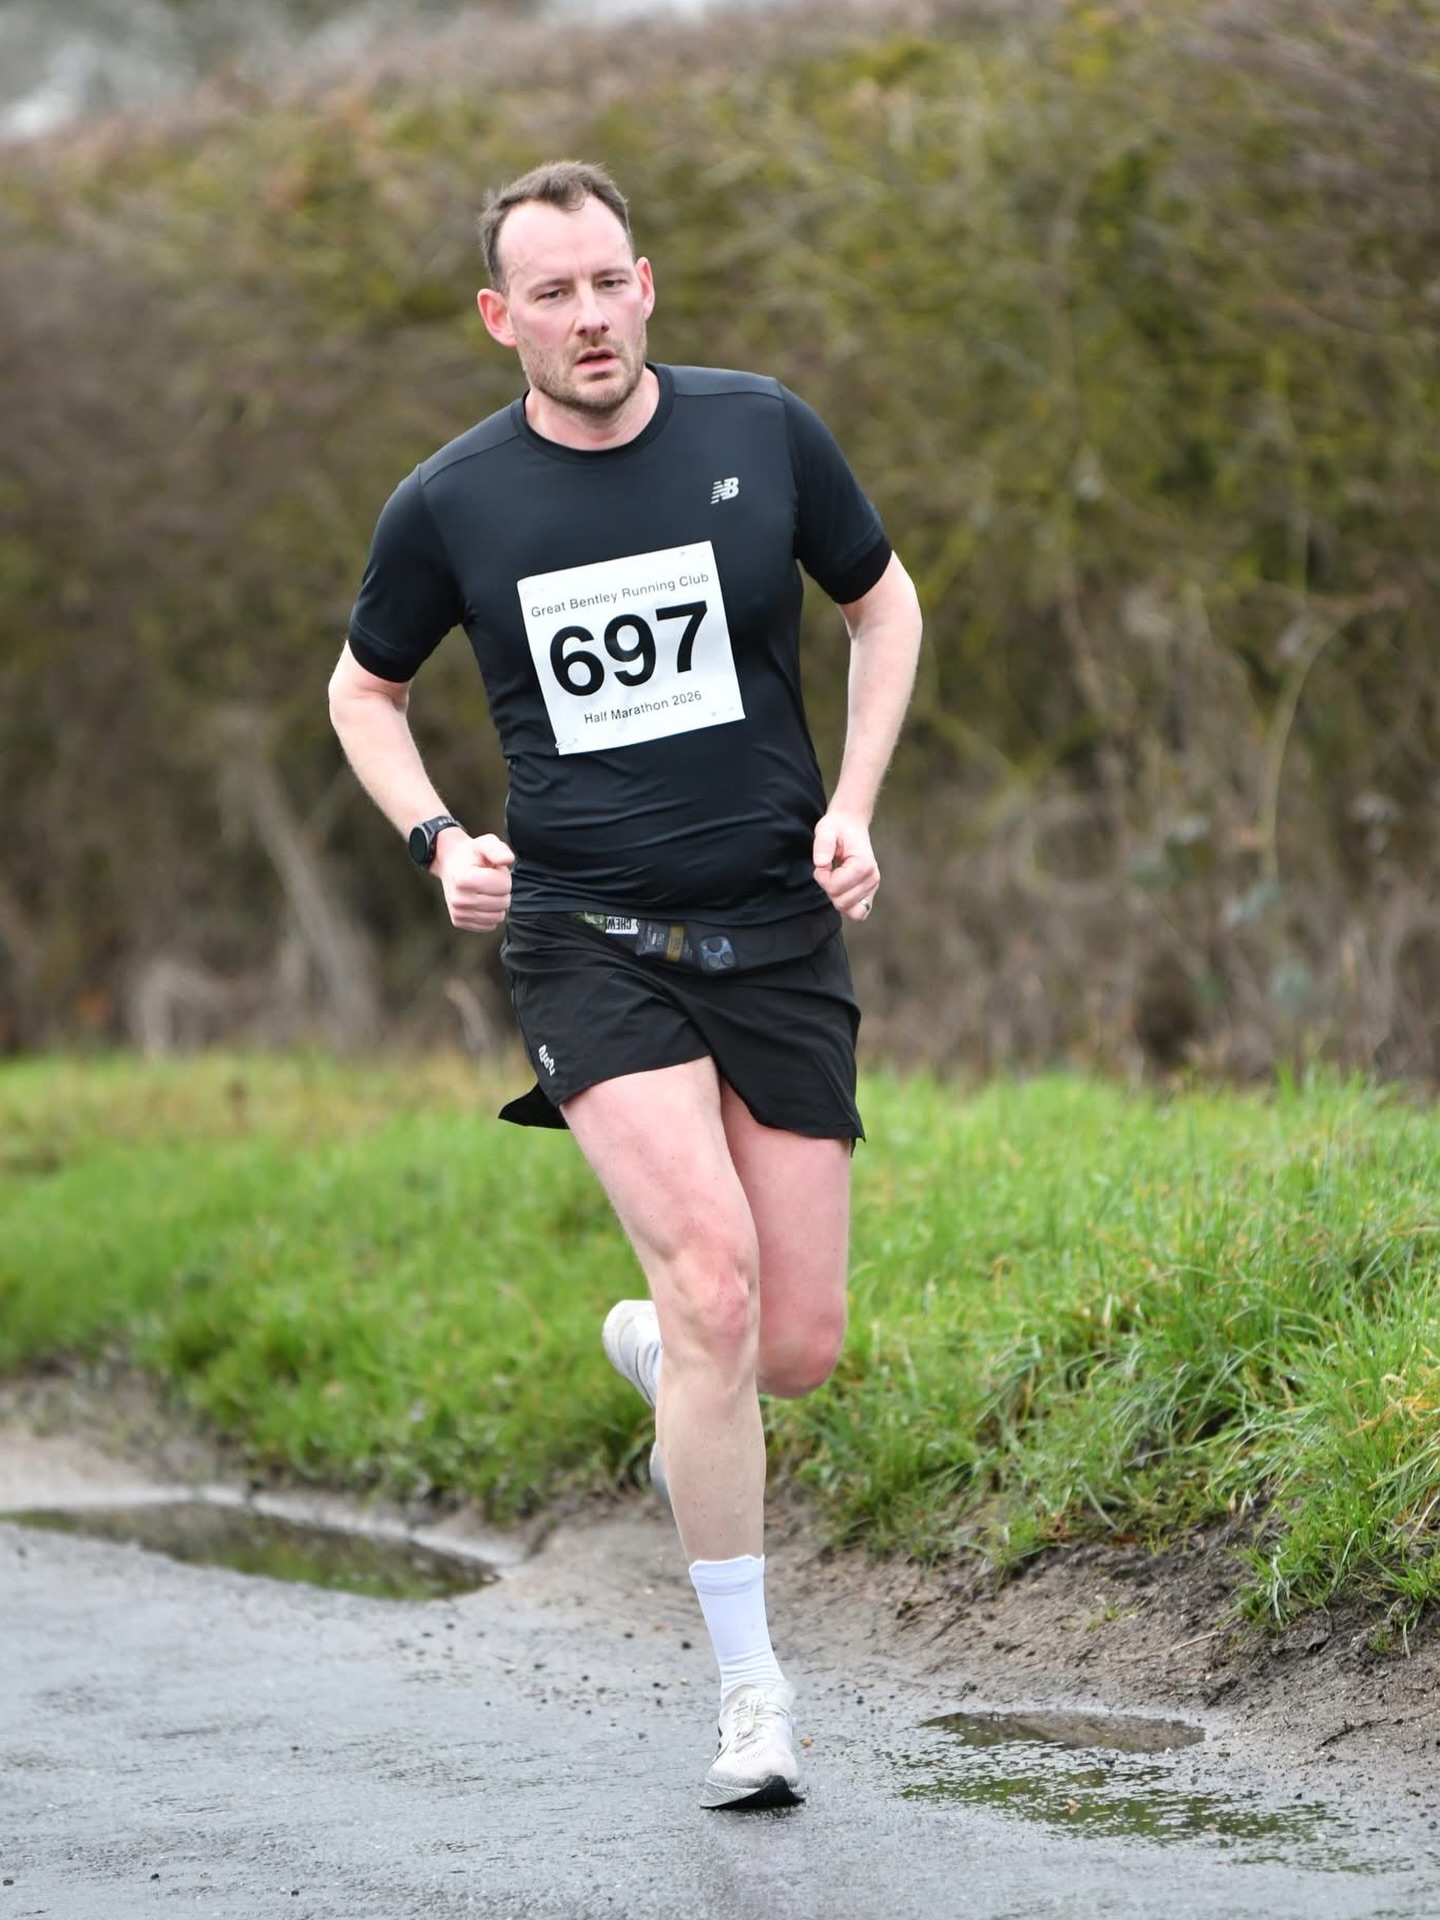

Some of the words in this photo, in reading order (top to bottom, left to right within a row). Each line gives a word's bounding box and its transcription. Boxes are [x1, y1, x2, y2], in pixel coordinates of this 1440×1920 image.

[531, 602, 566, 617] Great
[569, 592, 618, 609] Bentley
[621, 580, 676, 598] Running
[679, 573, 709, 587] Club
[550, 600, 708, 697] 697
[584, 710, 608, 724] Half
[611, 699, 669, 720] Marathon
[672, 690, 702, 706] 2026
